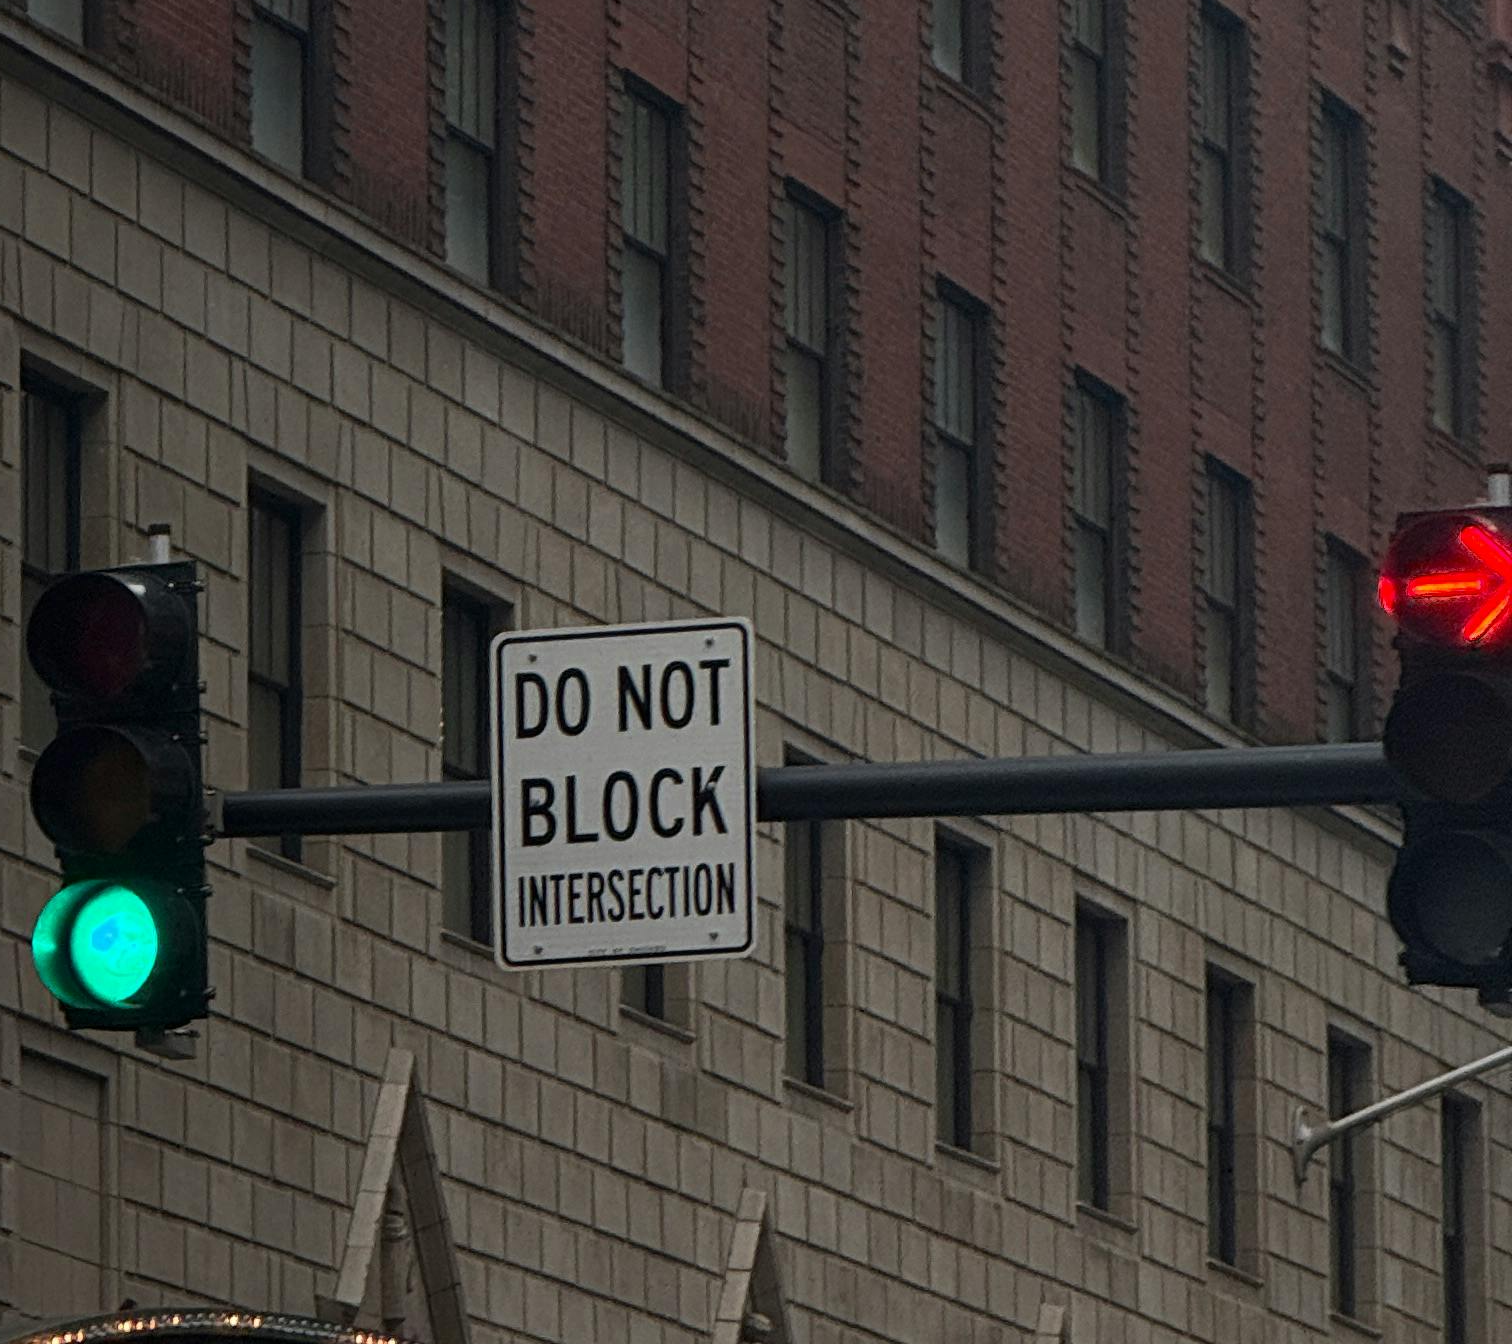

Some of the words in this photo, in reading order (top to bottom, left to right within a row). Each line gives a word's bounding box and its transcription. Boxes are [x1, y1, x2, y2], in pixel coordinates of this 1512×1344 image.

[515, 667, 591, 739] DO
[617, 658, 731, 732] NOT
[520, 765, 728, 847] BLOCK
[518, 862, 736, 928] INTERSECTION
